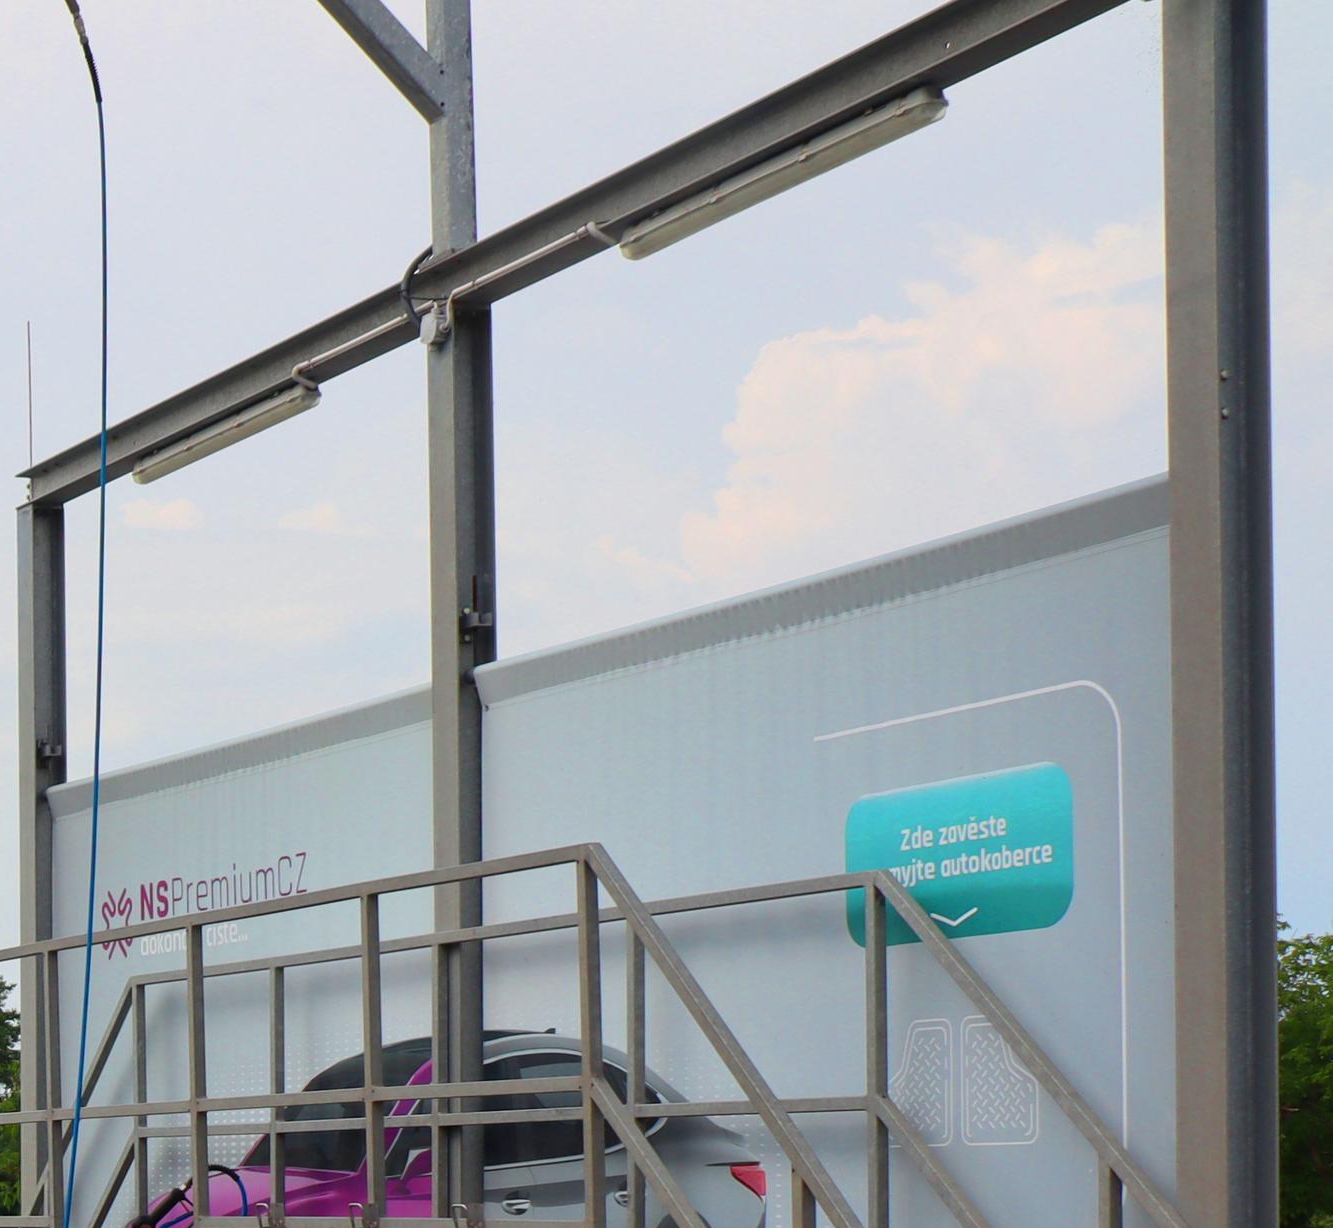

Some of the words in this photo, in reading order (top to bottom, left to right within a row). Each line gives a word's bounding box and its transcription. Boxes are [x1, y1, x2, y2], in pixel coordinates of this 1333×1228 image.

[900, 825, 934, 852] Zde
[938, 815, 1007, 846] zavěste
[940, 843, 1053, 879] autokoberce
[139, 851, 308, 921] NSPremiumCZ
